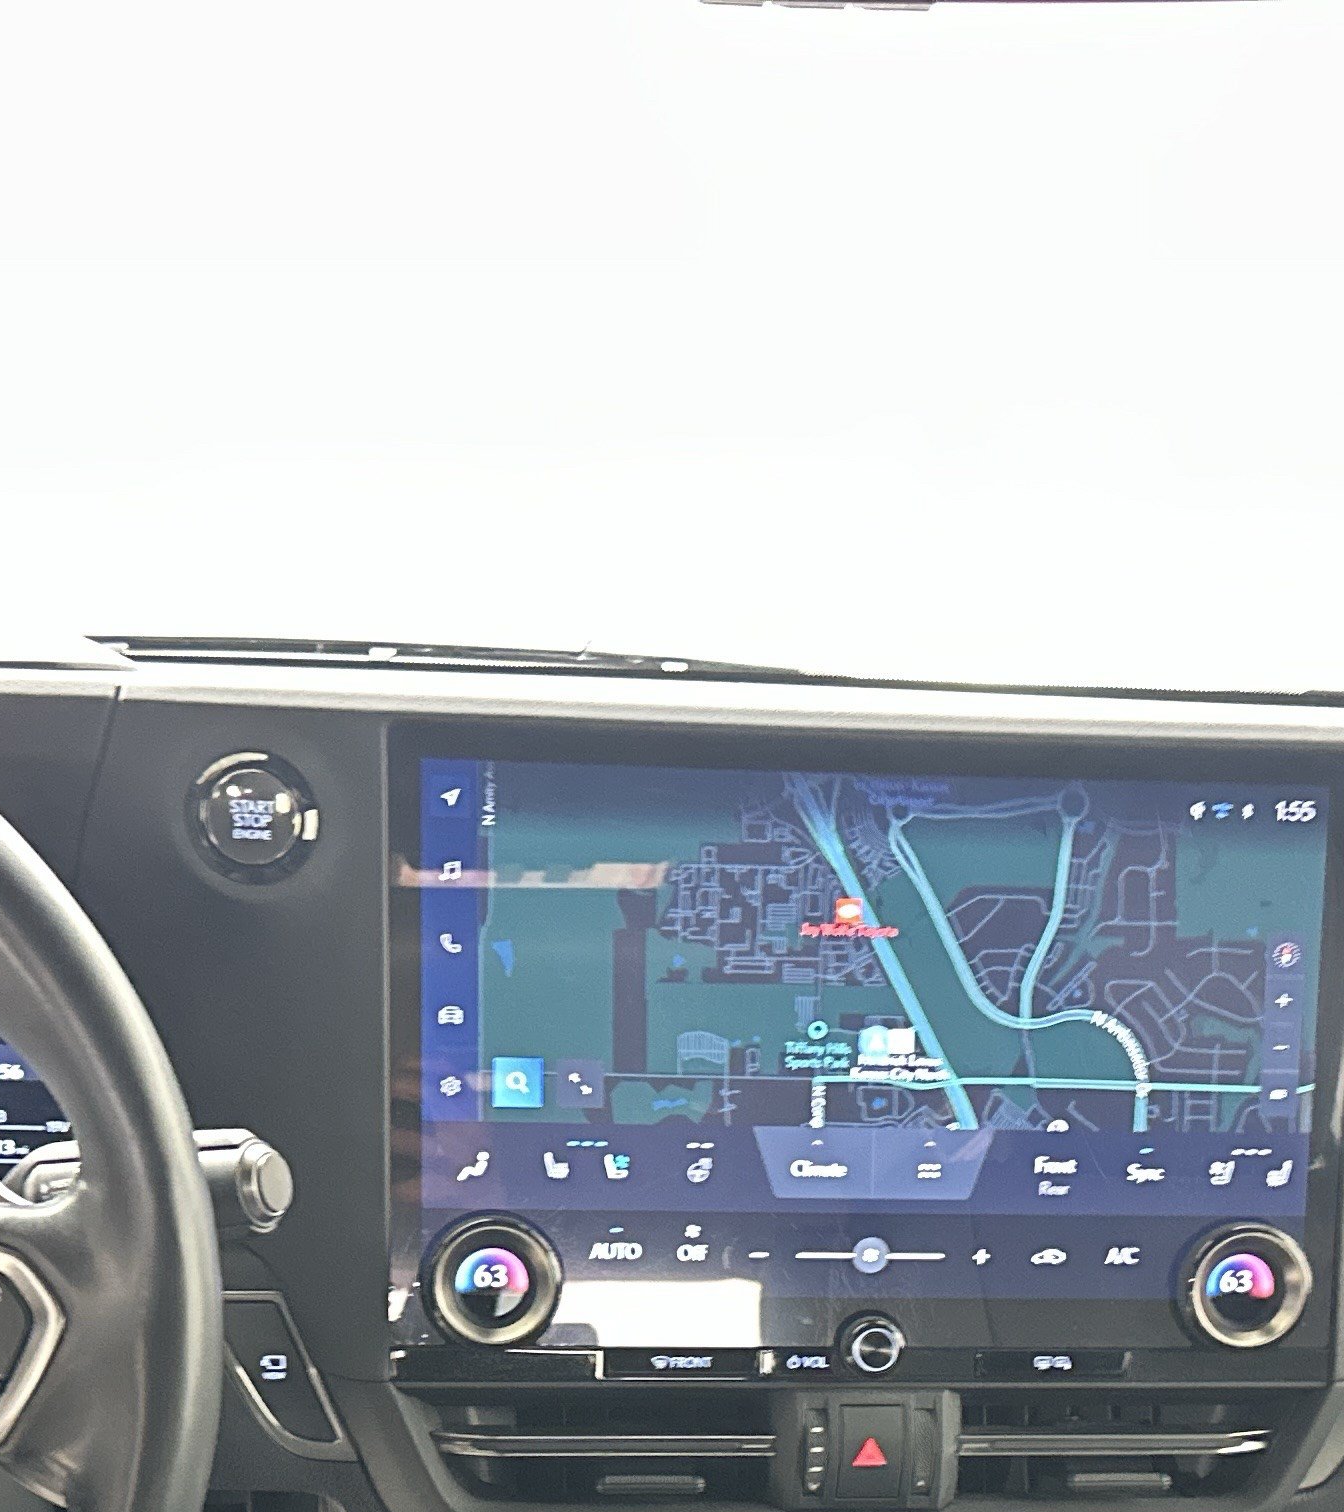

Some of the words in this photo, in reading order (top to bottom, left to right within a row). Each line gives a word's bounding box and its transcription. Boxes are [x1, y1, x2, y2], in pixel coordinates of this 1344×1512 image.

[232, 814, 273, 828] STOP
[1275, 801, 1317, 822] 1:55
[589, 1242, 643, 1260] AUTO
[676, 1243, 709, 1262] OFF
[472, 1264, 509, 1288] 63
[1219, 1270, 1253, 1293] 63
